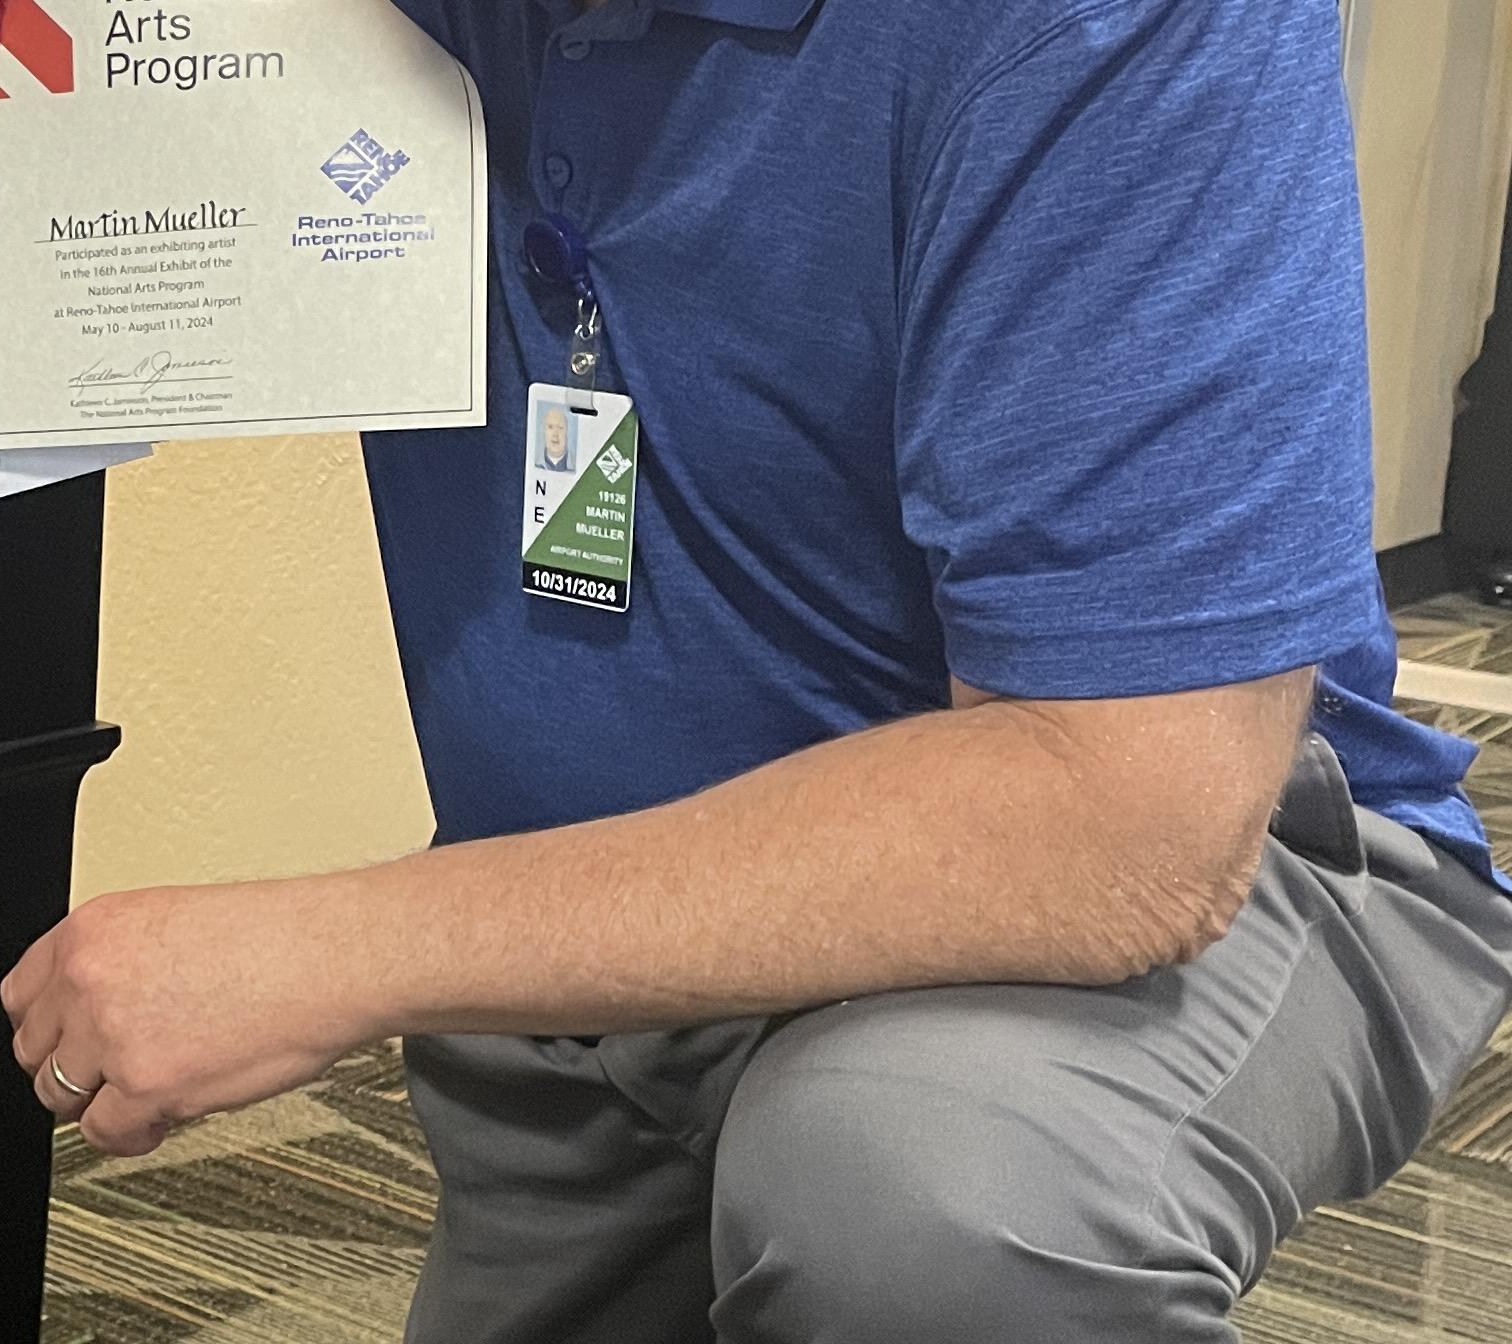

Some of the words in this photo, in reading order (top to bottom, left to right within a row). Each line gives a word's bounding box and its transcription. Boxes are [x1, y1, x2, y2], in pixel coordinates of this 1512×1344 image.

[105, 9, 191, 46] Arts
[106, 51, 285, 91] Program
[49, 209, 141, 242] Martin
[144, 200, 247, 234] Mueller
[298, 212, 427, 230] Reno-Tahoe
[292, 227, 435, 247] International
[55, 245, 119, 262] Participated
[120, 247, 133, 257] as
[135, 245, 148, 256] an
[150, 239, 206, 254] exhibiting
[207, 237, 236, 250] artist
[320, 247, 406, 262] Airport
[72, 266, 91, 279] the
[93, 266, 118, 277] 16th
[119, 262, 158, 275] Annual
[159, 259, 197, 272] Exhibit
[199, 257, 212, 269] of
[213, 256, 233, 268] the
[87, 282, 133, 296] National
[134, 281, 157, 294] Arts
[158, 279, 206, 295] Program
[54, 307, 65, 318] at
[66, 304, 130, 318] Reno-Tahoe
[130, 297, 200, 313] International
[202, 295, 242, 311] Airport
[81, 324, 104, 338] May
[106, 323, 120, 334] 10
[128, 320, 166, 334] August
[186, 316, 214, 329] 2024
[536, 479, 547, 497] N
[534, 506, 545, 524] E
[585, 505, 626, 523] MARTIN
[575, 522, 625, 541] MUELLER
[531, 569, 617, 602] 10/31/2024
